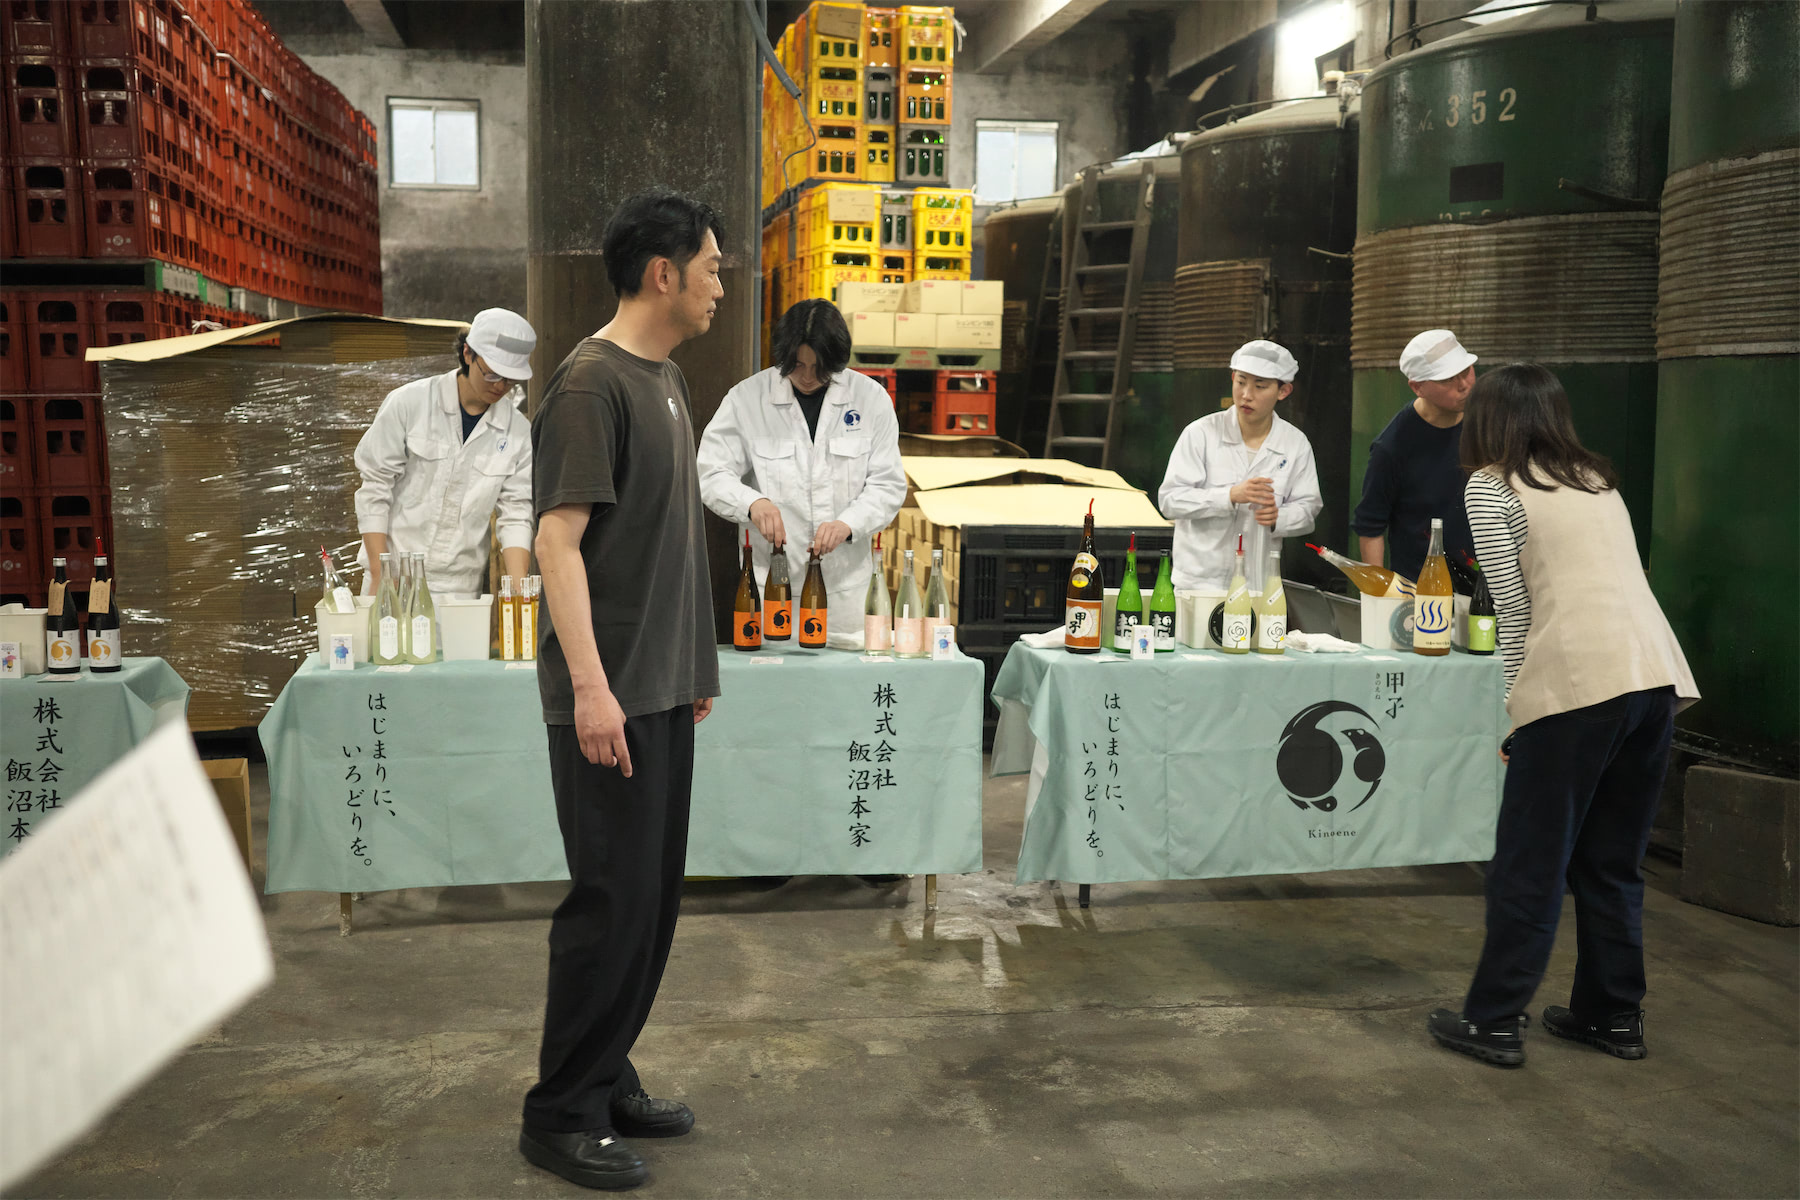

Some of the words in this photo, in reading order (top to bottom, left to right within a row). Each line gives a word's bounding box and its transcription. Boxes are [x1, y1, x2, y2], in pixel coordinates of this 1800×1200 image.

[1446, 88, 1516, 127] 352
[1069, 612, 1087, 634] 甲子
[873, 683, 898, 788] 株式会社
[1386, 672, 1404, 719] 甲子
[33, 697, 64, 811] 株式会社
[369, 693, 396, 816] はじまりに、
[847, 740, 872, 848] 飯沼本家
[1082, 740, 1104, 858] いろどりを。
[1104, 693, 1125, 811] はじまりに、
[4, 758, 34, 857] 飯沼本
[343, 744, 372, 867] いろどりを。
[1308, 829, 1357, 839] Kinoene
